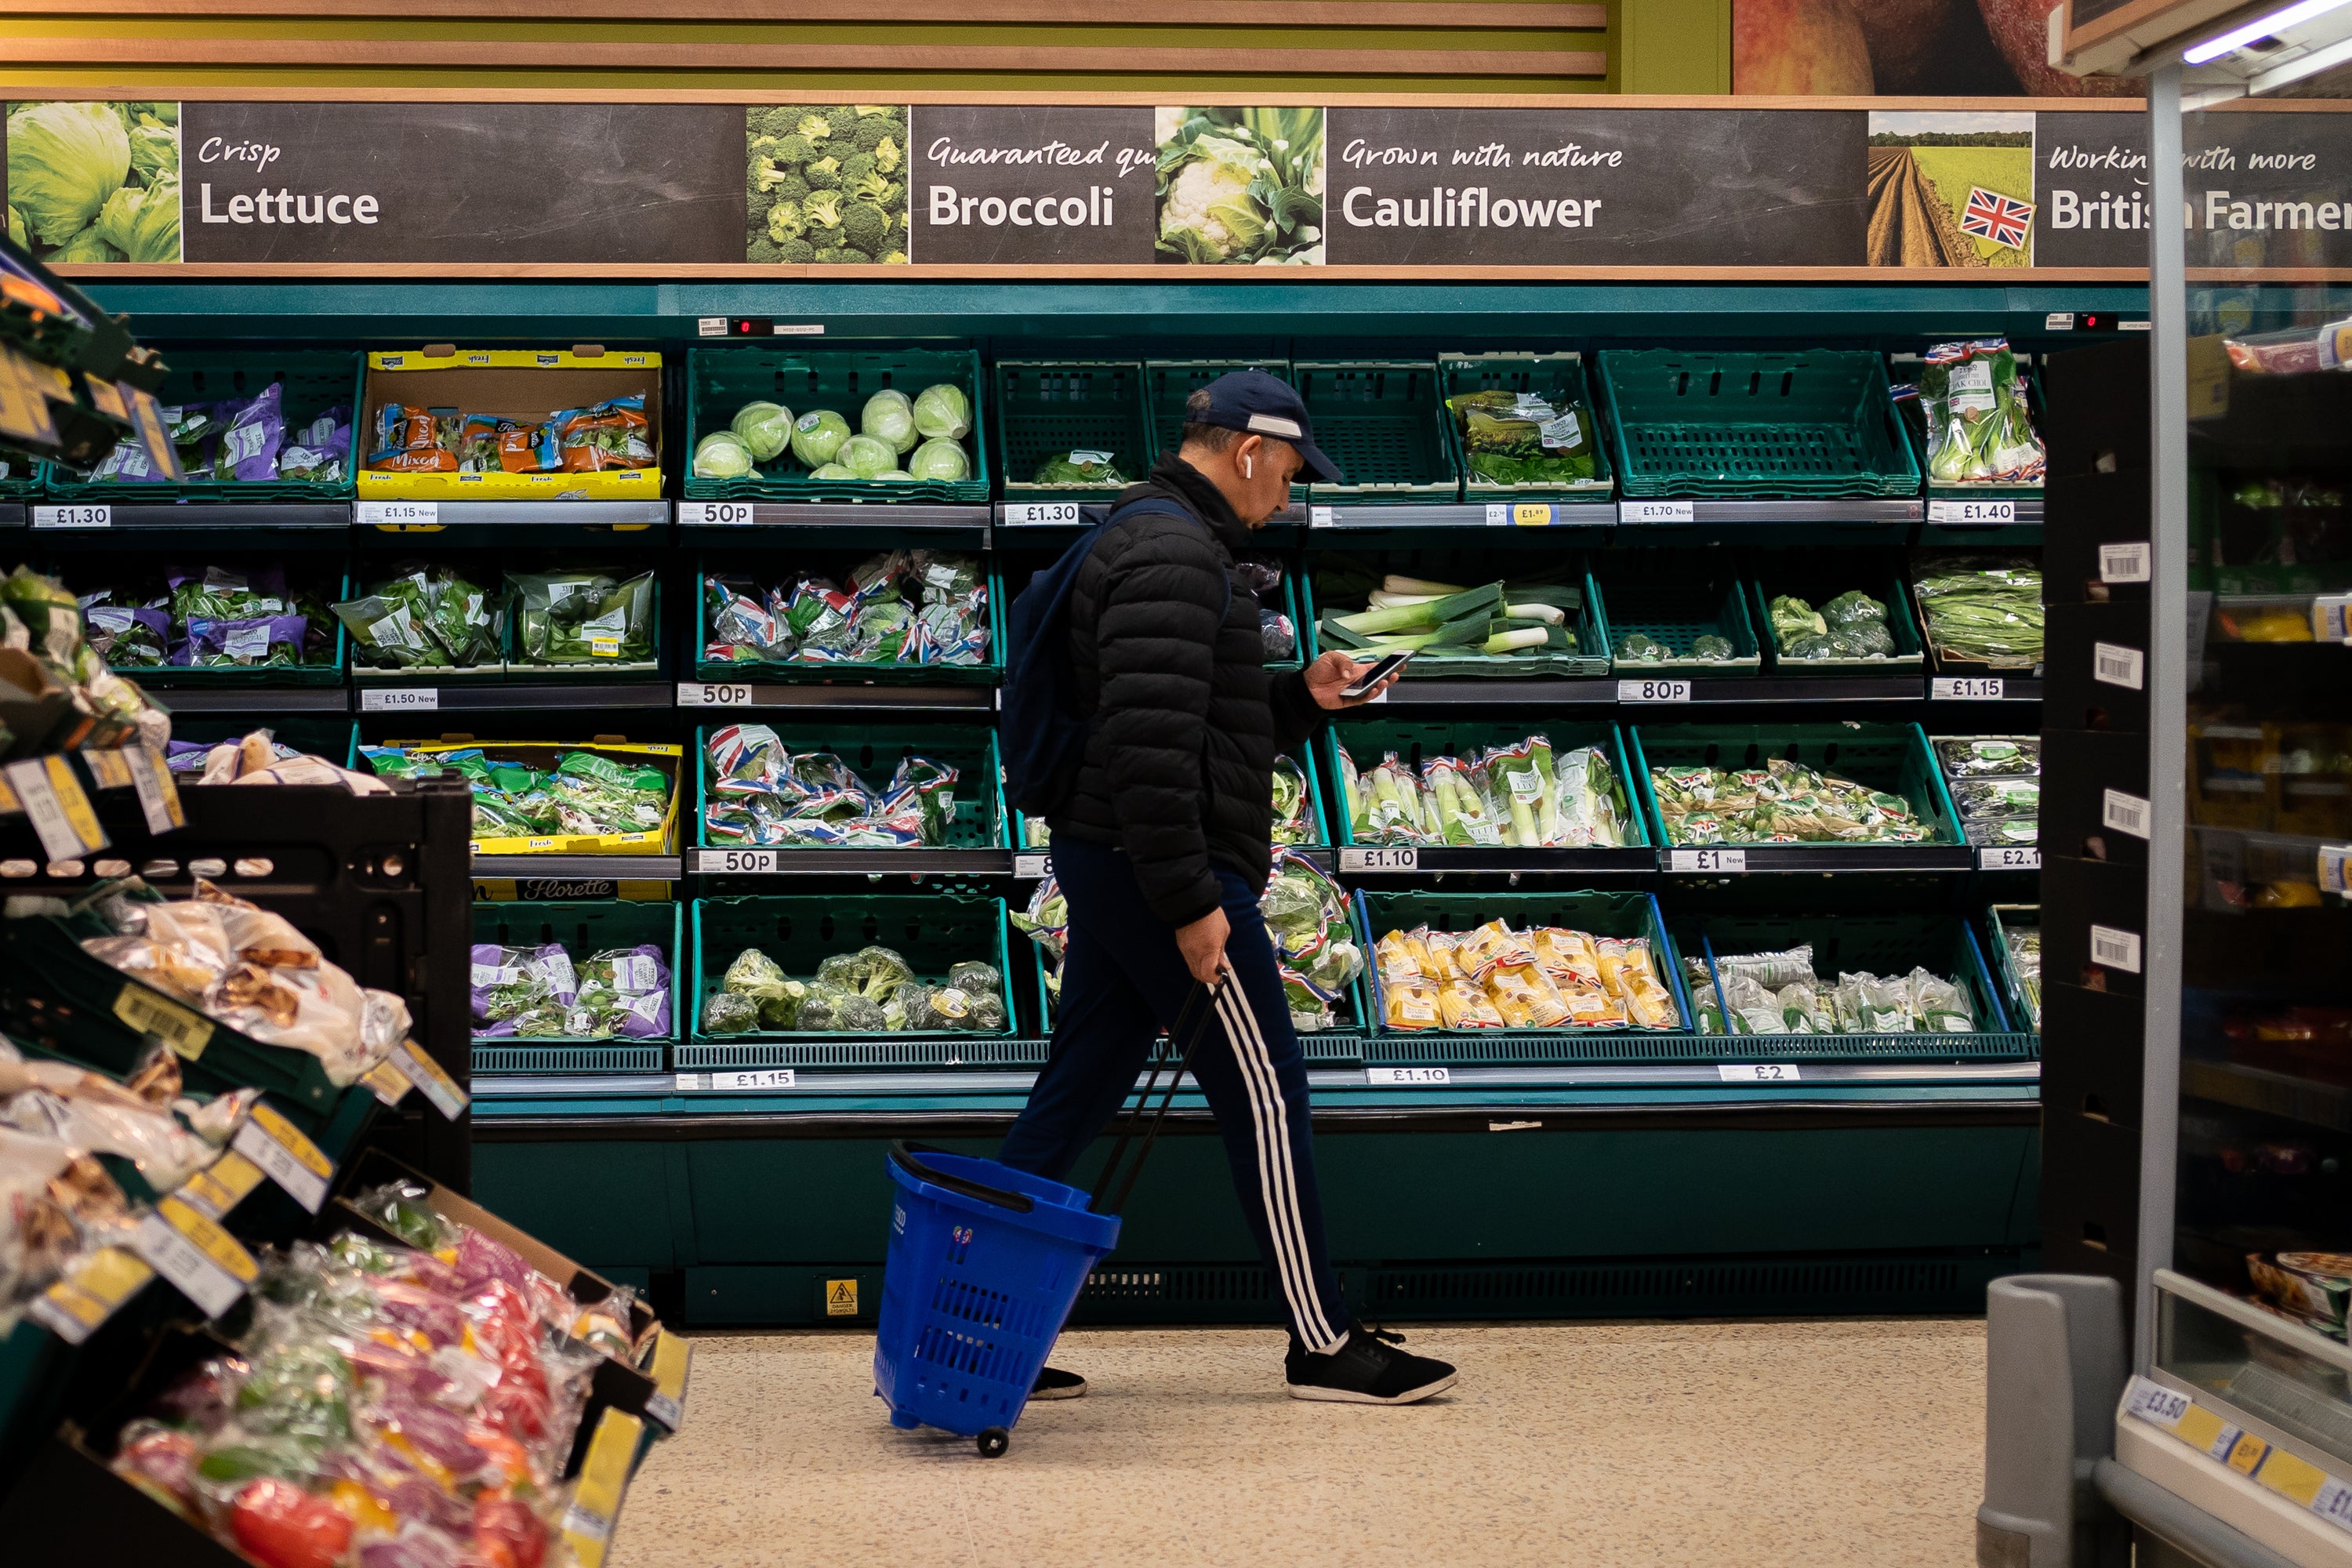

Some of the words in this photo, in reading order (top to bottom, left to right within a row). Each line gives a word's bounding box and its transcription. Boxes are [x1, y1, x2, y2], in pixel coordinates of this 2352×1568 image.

[199, 136, 281, 172] Crisp
[928, 137, 1110, 167] Guaranteed
[1116, 148, 1156, 178] qu
[1343, 139, 1438, 169] Grown
[1452, 143, 1511, 168] with
[1523, 143, 1623, 168] nature
[2049, 146, 2150, 186] Workin
[2182, 146, 2236, 171] with
[2249, 153, 2316, 171] more
[201, 183, 379, 224] Lettuce
[929, 185, 1113, 227] Broccoli
[1342, 187, 1602, 228] Cauliflower
[2052, 191, 2193, 230] Briti
[741, 321, 750, 332] 0
[393, 450, 440, 466] Mixed
[56, 508, 107, 524] £1.30
[385, 507, 416, 517] £1.15
[704, 504, 747, 523] 50p
[1027, 506, 1076, 521] £1.30
[1522, 509, 1544, 518] £1.89
[1643, 506, 1673, 516] £1.70
[1964, 506, 2011, 519] £1.40
[702, 684, 746, 703] 50p
[1642, 681, 1684, 699] 80p
[1952, 679, 2000, 696] £1.15
[384, 694, 416, 703] £1.50
[591, 757, 638, 786] Crispy
[529, 839, 553, 848] Fresh
[725, 851, 770, 871] 50p
[1364, 850, 1414, 867] £1.10
[1697, 850, 1720, 869] £1
[2003, 850, 2039, 865] £2.1
[524, 879, 613, 901] Florette
[736, 1072, 789, 1087] £1.15
[1392, 1069, 1446, 1082] £1.10
[1755, 1065, 1784, 1080] £2
[2146, 1389, 2188, 1421] £3.50
[2329, 1490, 2352, 1521] £1.
